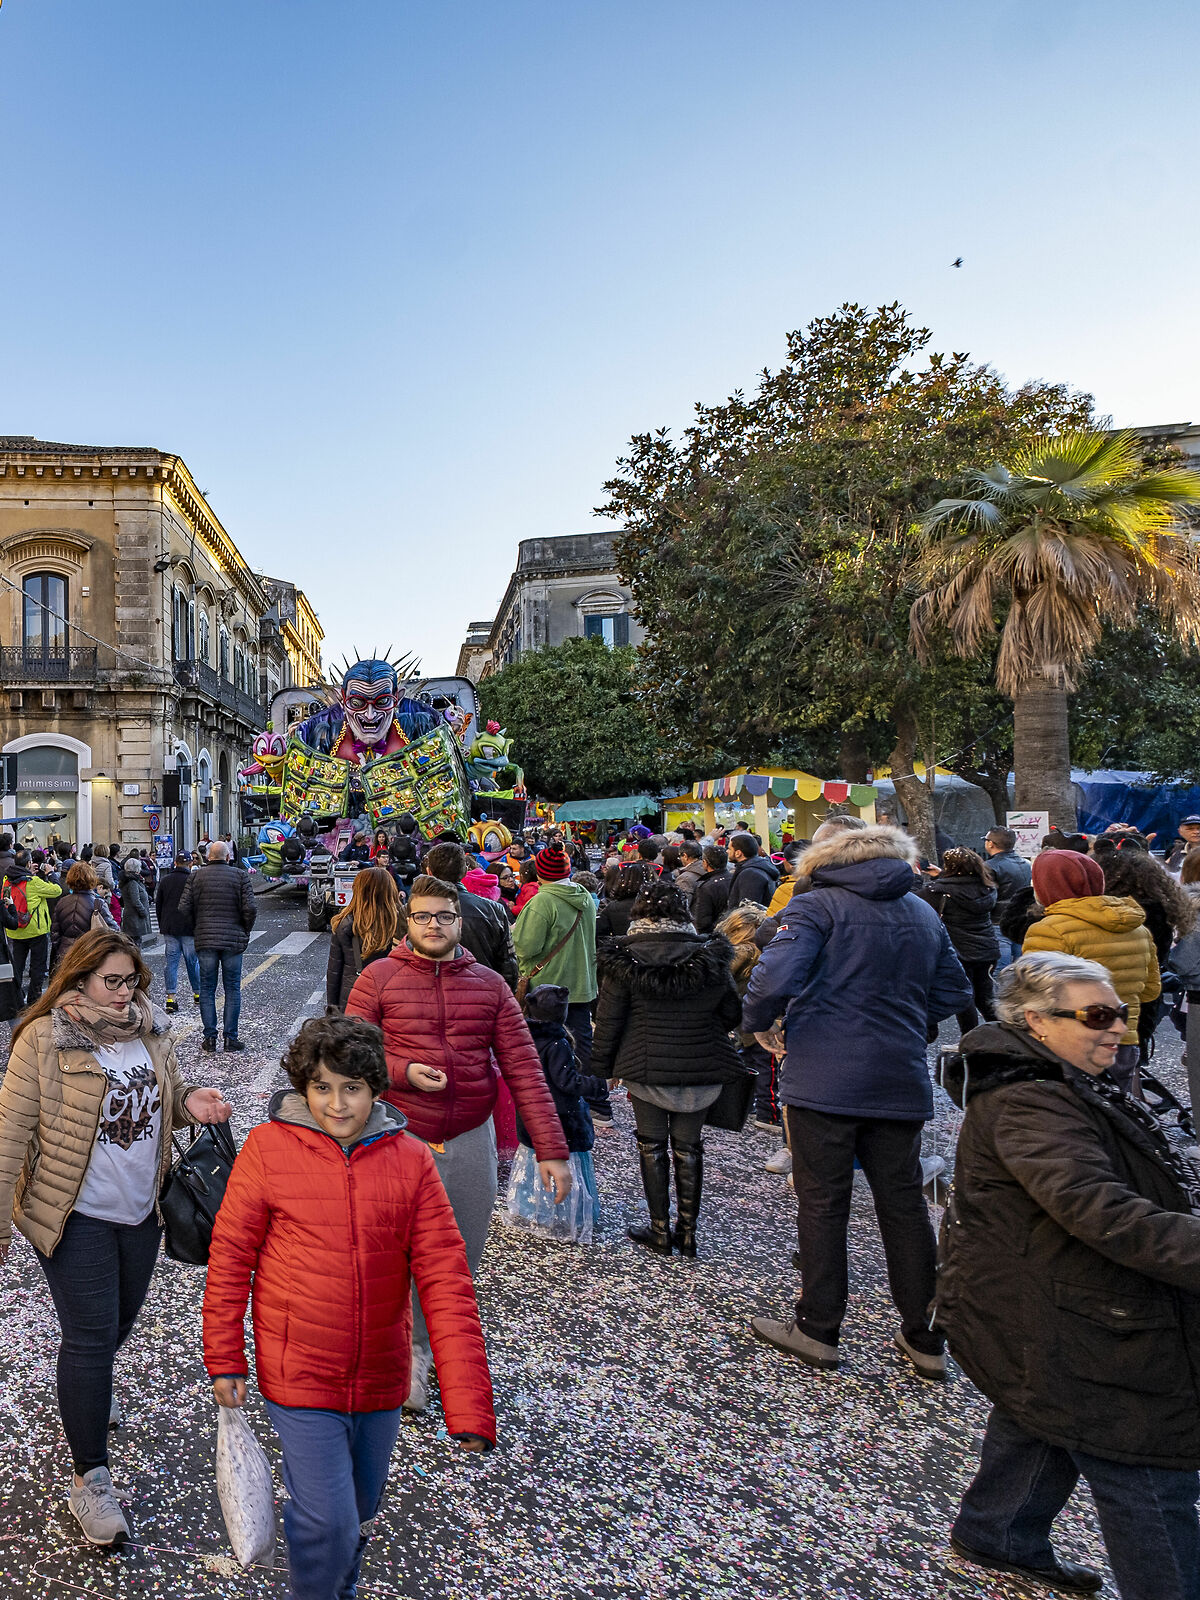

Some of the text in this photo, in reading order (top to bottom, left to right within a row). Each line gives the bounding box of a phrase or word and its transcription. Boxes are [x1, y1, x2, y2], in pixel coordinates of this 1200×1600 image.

[19, 780, 74, 788] intimissimi
[337, 892, 346, 905] 3
[122, 1062, 151, 1081] MY
